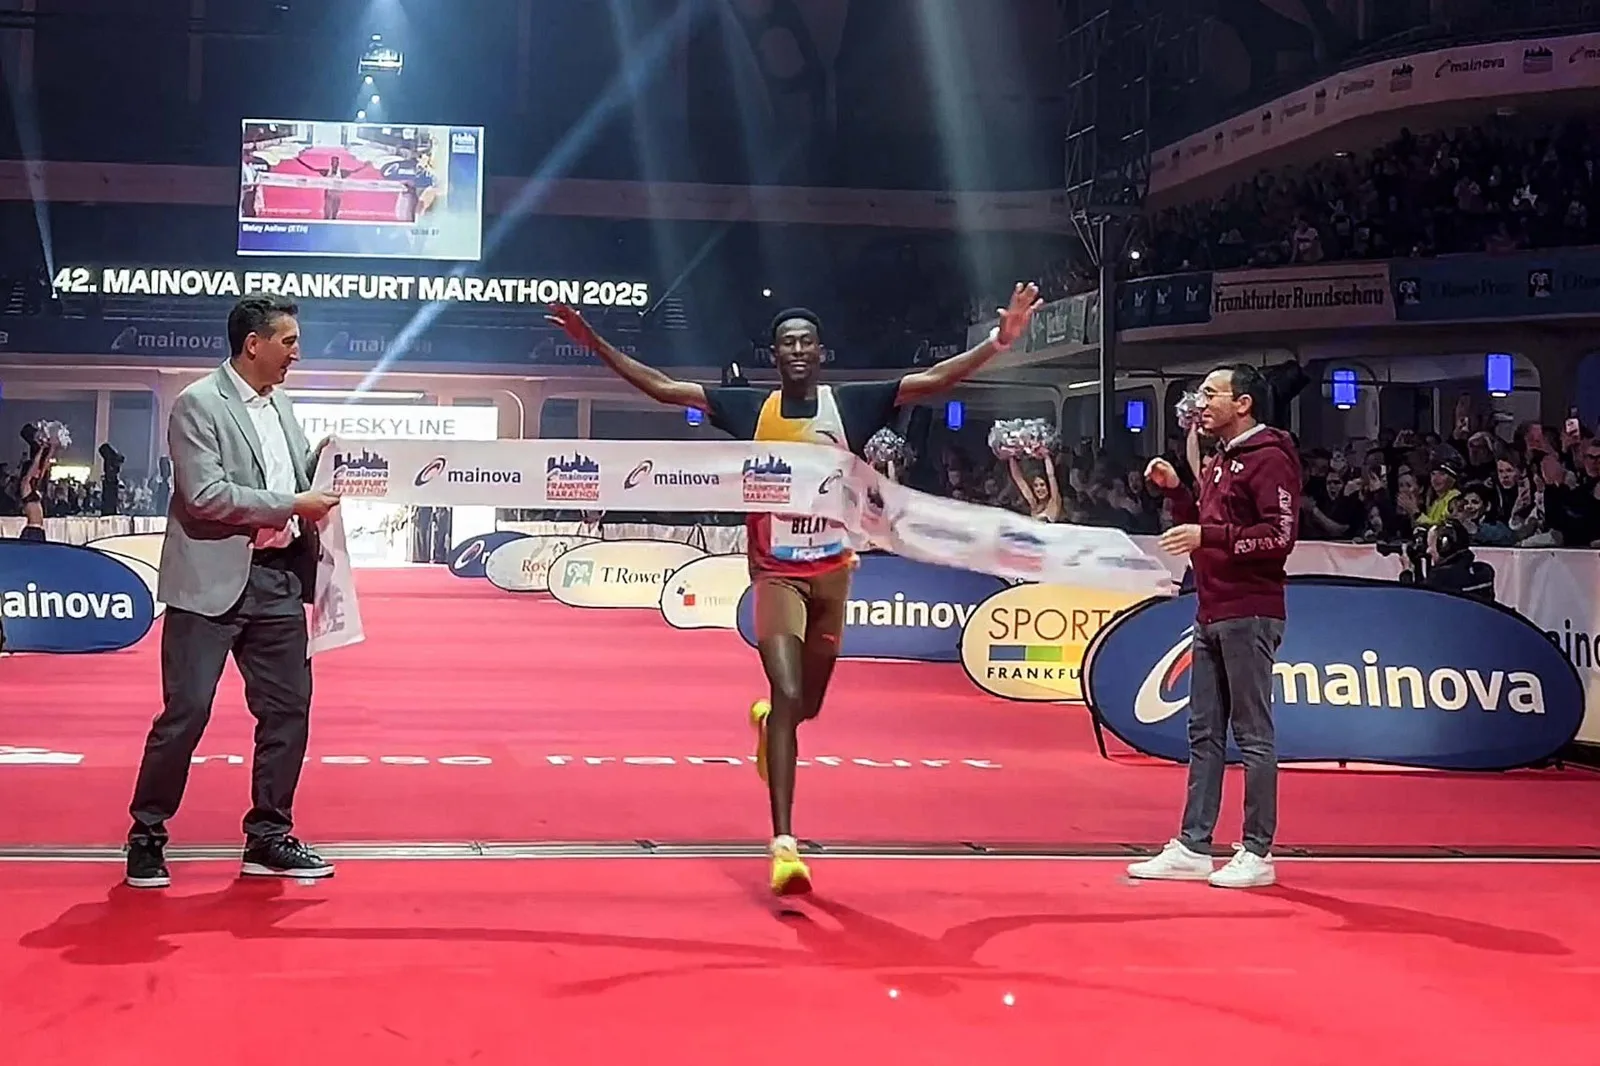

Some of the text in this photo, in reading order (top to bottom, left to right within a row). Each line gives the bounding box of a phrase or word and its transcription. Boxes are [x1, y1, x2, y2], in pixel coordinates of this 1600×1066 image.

[53, 267, 649, 306] 42. MAINOVA FRANKFURT MARATHON 2025
[1292, 284, 1384, 310] Rundschau
[138, 331, 225, 350] mainova
[346, 468, 388, 478] mainova
[448, 467, 521, 483] mainova
[653, 469, 720, 486] mainova
[546, 482, 599, 490] FRANKFURT
[546, 490, 599, 498] MARATHON
[0, 582, 134, 619] ainova
[846, 592, 978, 629] mainov
[988, 607, 1113, 641] SPORT
[986, 666, 1082, 680] FRANKFU
[1270, 650, 1546, 715] mainova
